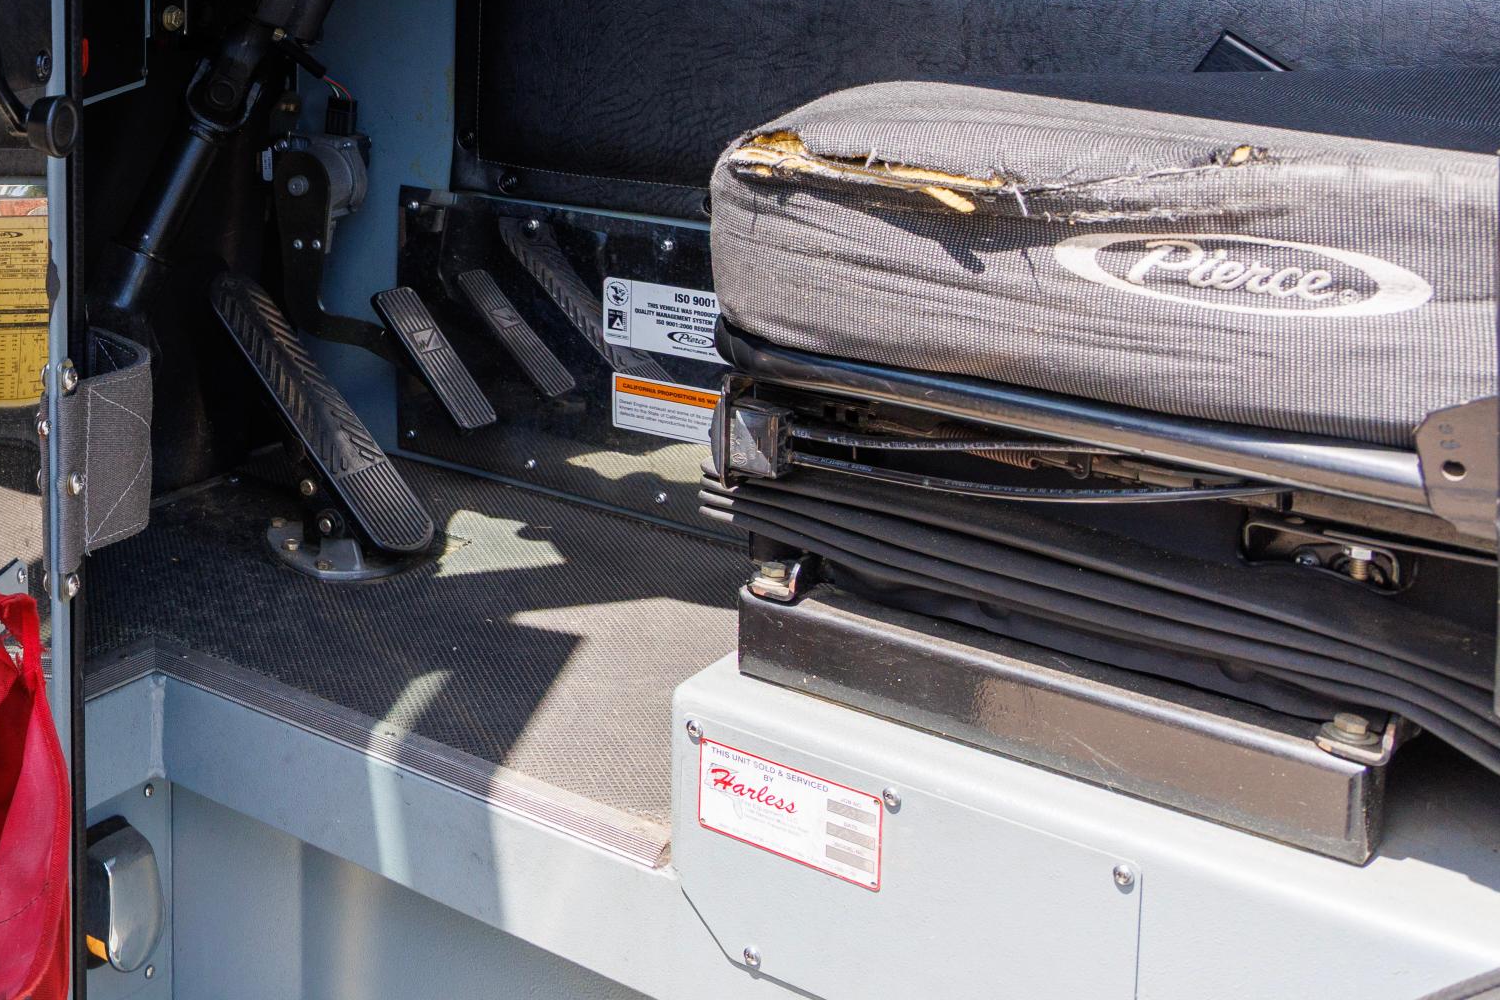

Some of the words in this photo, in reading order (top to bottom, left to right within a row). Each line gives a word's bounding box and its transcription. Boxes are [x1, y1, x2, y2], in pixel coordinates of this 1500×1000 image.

[1128, 239, 1335, 301] Pierce
[674, 292, 689, 303] ISO
[692, 295, 715, 307] 9001
[656, 311, 690, 322] MANAGEMENT
[692, 317, 712, 325] SYSTEM
[659, 304, 679, 312] VEHICLE
[693, 309, 716, 318] PRODUCE
[678, 332, 706, 346] Pierce
[623, 383, 655, 393] CALIFORNIA
[657, 389, 696, 401] PROPOSITION
[711, 745, 729, 758] THIS
[732, 753, 750, 765] UNIT
[753, 760, 775, 774] SOLD
[778, 769, 783, 777] &
[786, 772, 828, 793] SERVICED
[763, 774, 773, 783] BY
[711, 768, 797, 814] Harless
